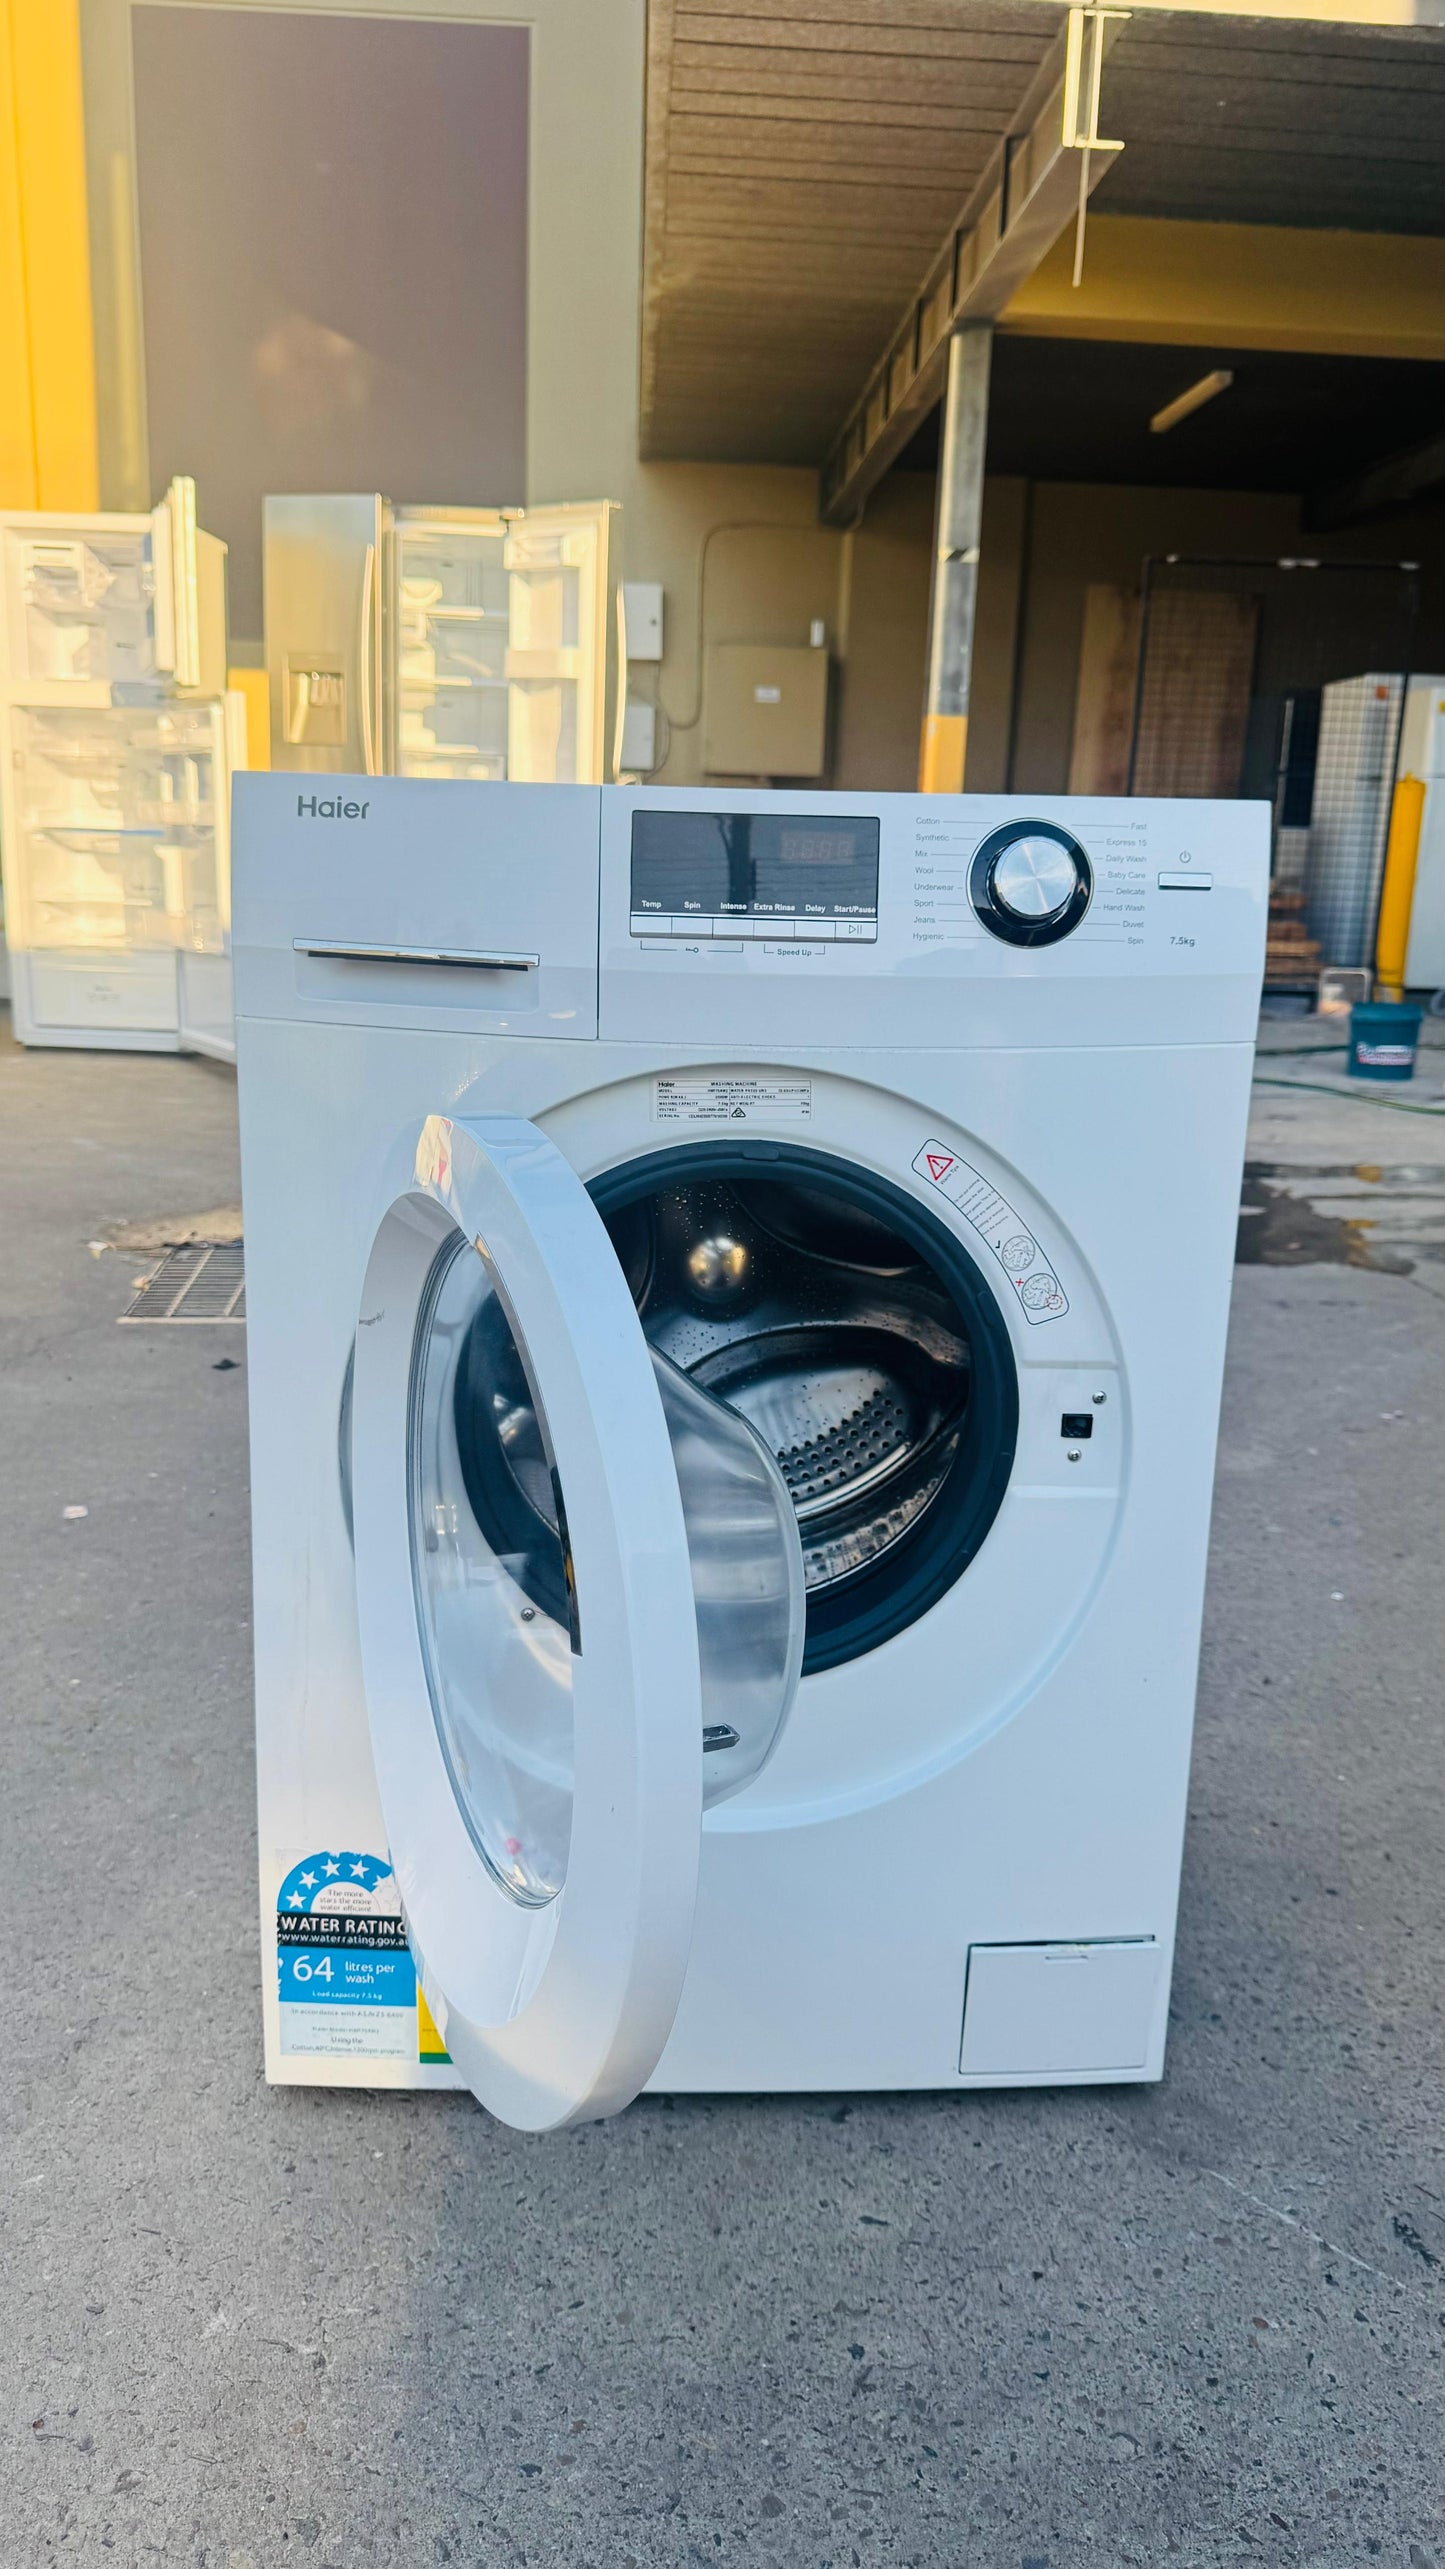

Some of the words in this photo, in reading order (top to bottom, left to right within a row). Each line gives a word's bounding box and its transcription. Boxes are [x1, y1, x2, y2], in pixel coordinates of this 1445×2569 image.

[298, 795, 370, 819] Haier
[916, 817, 941, 825] Cotton
[1130, 822, 1147, 830] Fast
[915, 833, 950, 842] Synthetic
[1106, 838, 1136, 846] Express
[1138, 839, 1148, 847] 15
[1105, 854, 1124, 864] Daily
[1125, 855, 1147, 863] Wash
[915, 866, 934, 874] Wool
[1107, 871, 1126, 880] Baby
[1128, 871, 1146, 879] Care
[914, 882, 954, 891] Underwear
[1115, 888, 1145, 896] Delicate
[641, 900, 662, 909] Temp
[684, 901, 701, 910] Spin
[720, 902, 747, 910] Intense
[753, 903, 773, 911] Extra
[774, 903, 795, 911] Rinse
[913, 899, 934, 907] Sport
[805, 904, 826, 913] Delay
[834, 905, 876, 913] Start/Pause
[913, 916, 936, 924] Jeans
[1122, 920, 1144, 928] Duvet
[912, 933, 944, 941] Hygienic
[1127, 937, 1144, 945] Spin
[1170, 936, 1195, 947] 7.5kg
[777, 948, 800, 957] Speed
[801, 949, 812, 957] Up
[328, 1889, 342, 1897] The
[343, 1904, 372, 1912] efficient
[281, 1916, 340, 1932] WATER
[293, 1955, 335, 1983] 64
[345, 1960, 374, 1973] litres
[376, 1963, 396, 1975] per
[345, 1974, 375, 1984] wash
[331, 1991, 360, 1999] capacity
[373, 1992, 383, 2000] kg
